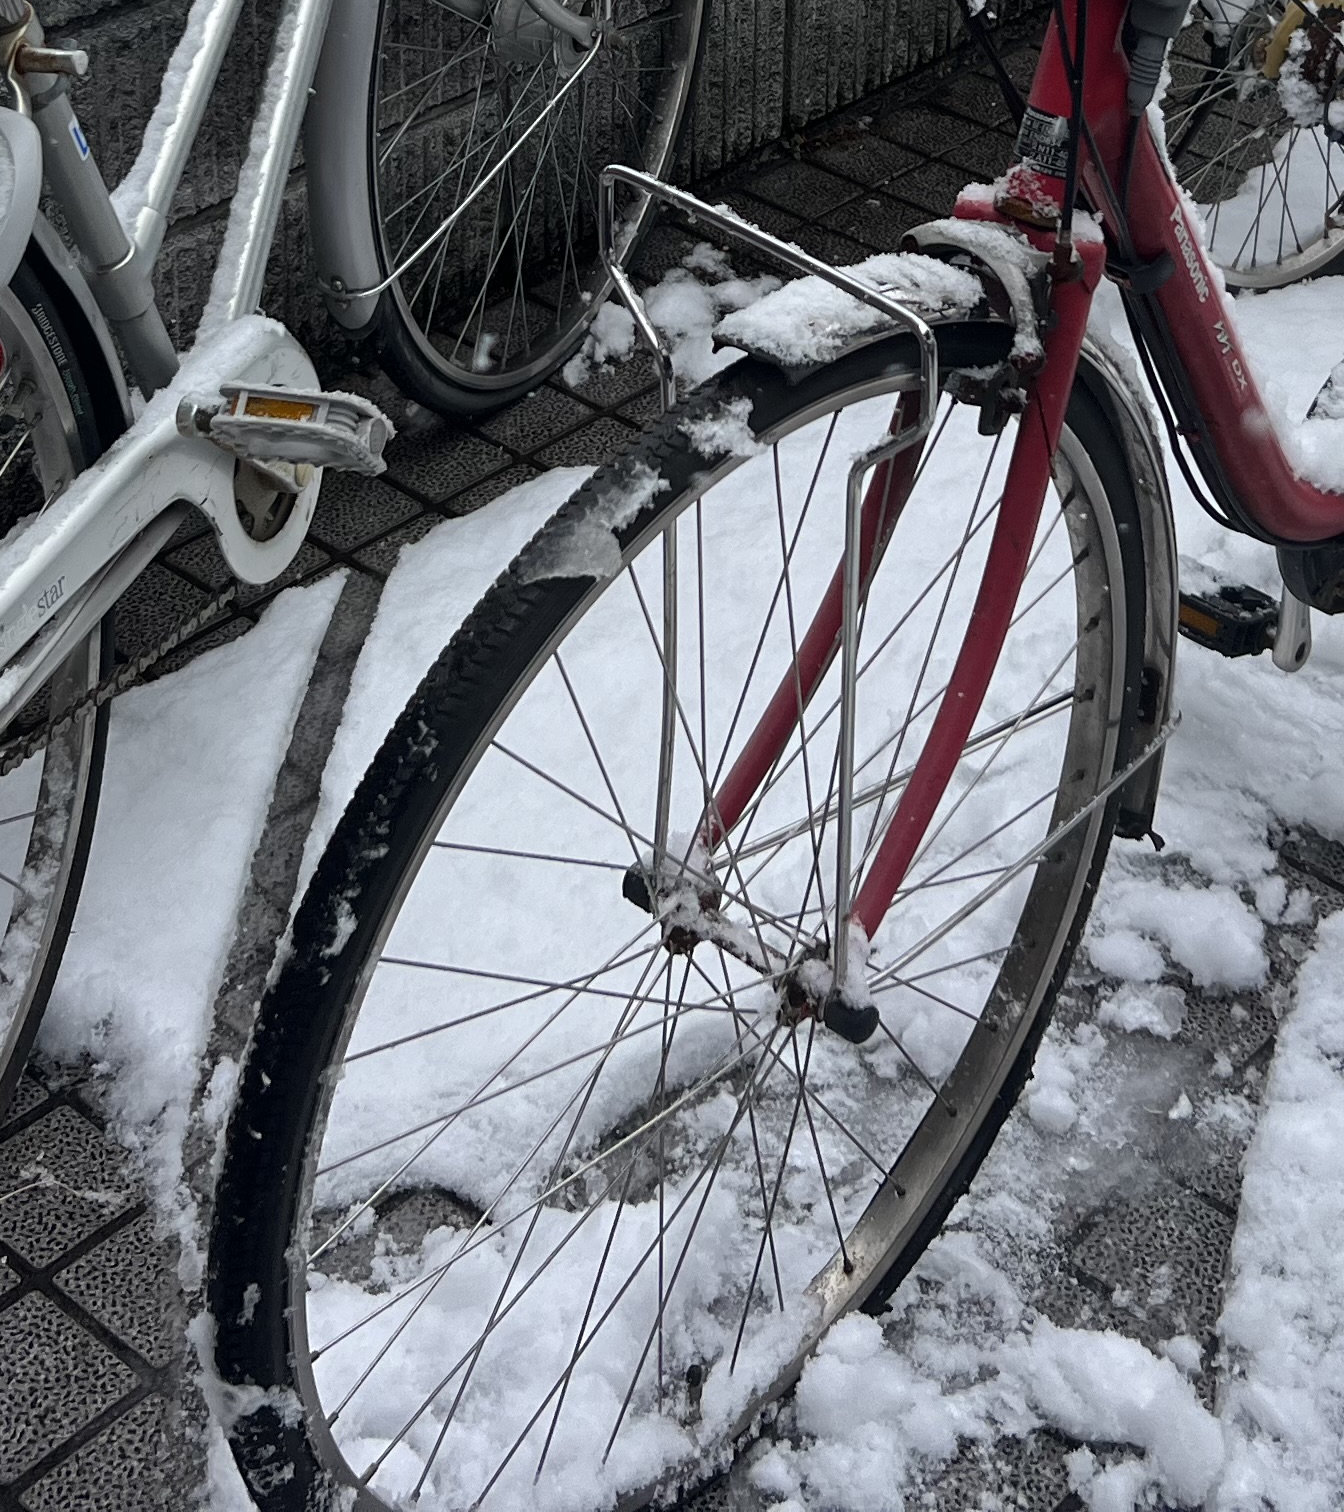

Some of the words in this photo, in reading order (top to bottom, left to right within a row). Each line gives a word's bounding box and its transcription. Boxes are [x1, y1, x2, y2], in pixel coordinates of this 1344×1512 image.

[1170, 202, 1210, 303] Panasonic
[32, 303, 68, 367] BRIDGESTONE
[1231, 358, 1248, 391] DX
